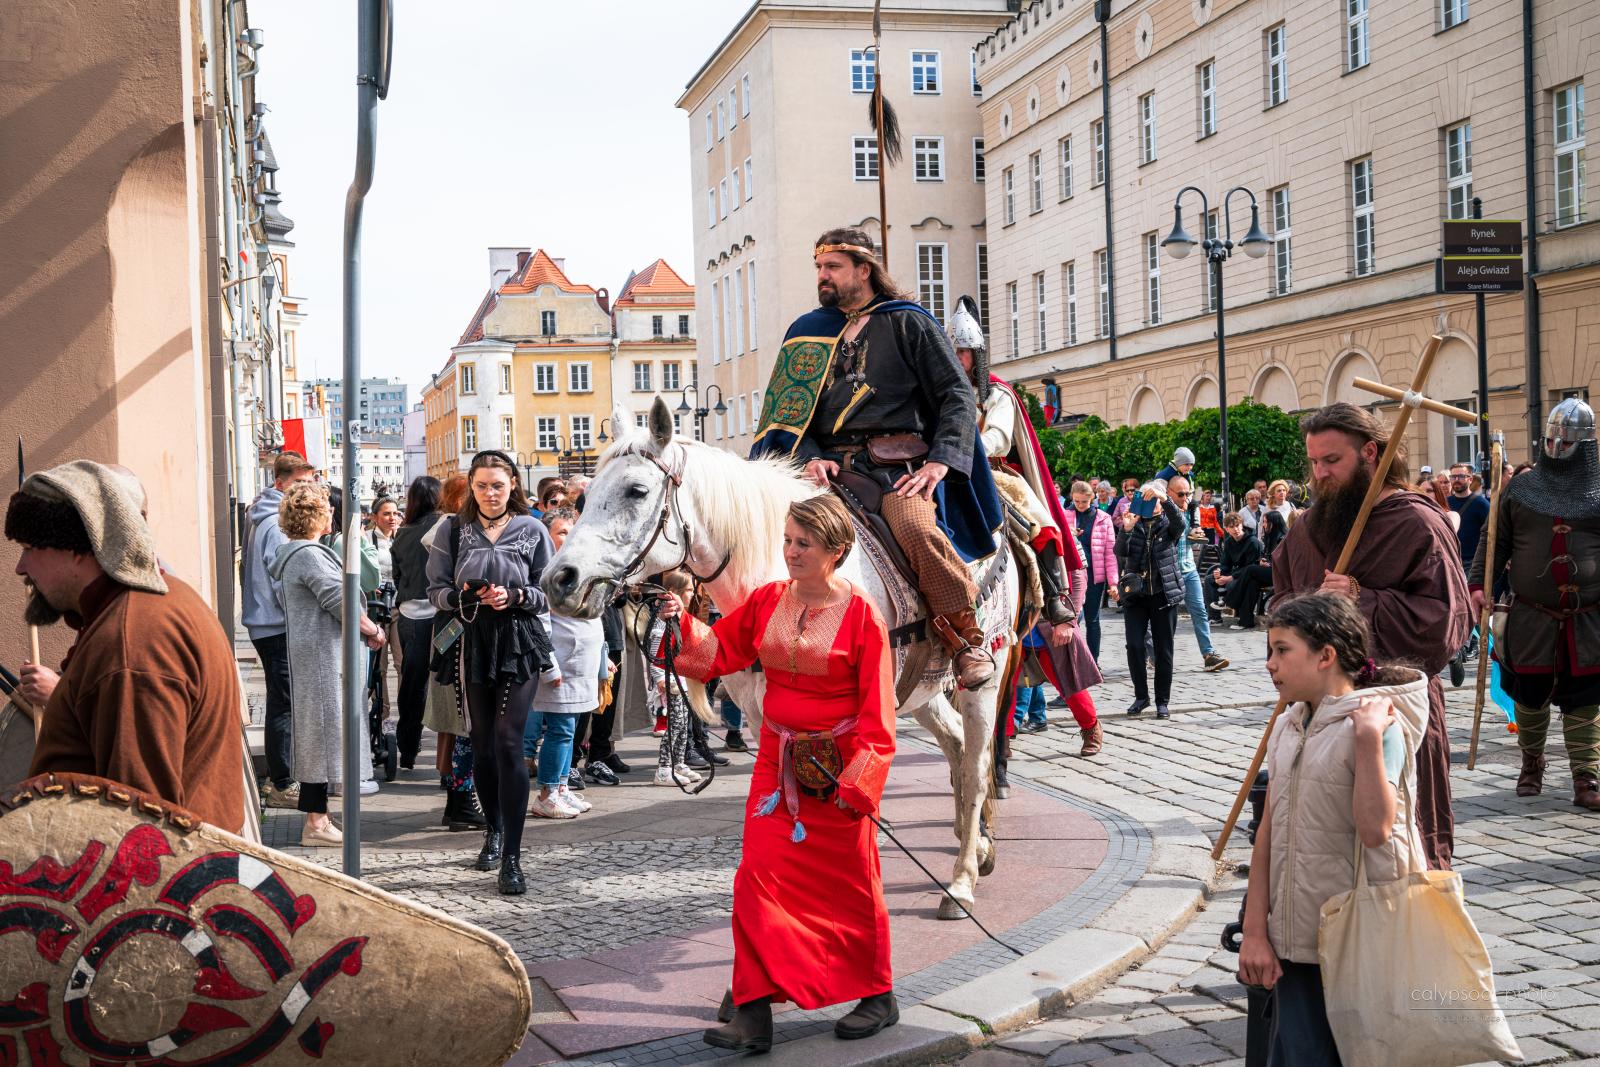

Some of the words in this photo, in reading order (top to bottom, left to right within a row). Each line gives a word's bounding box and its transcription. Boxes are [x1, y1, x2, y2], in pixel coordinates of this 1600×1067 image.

[1471, 229, 1496, 240] Rynek
[1457, 266, 1478, 277] Aleja
[1480, 265, 1510, 275] Gwiazd
